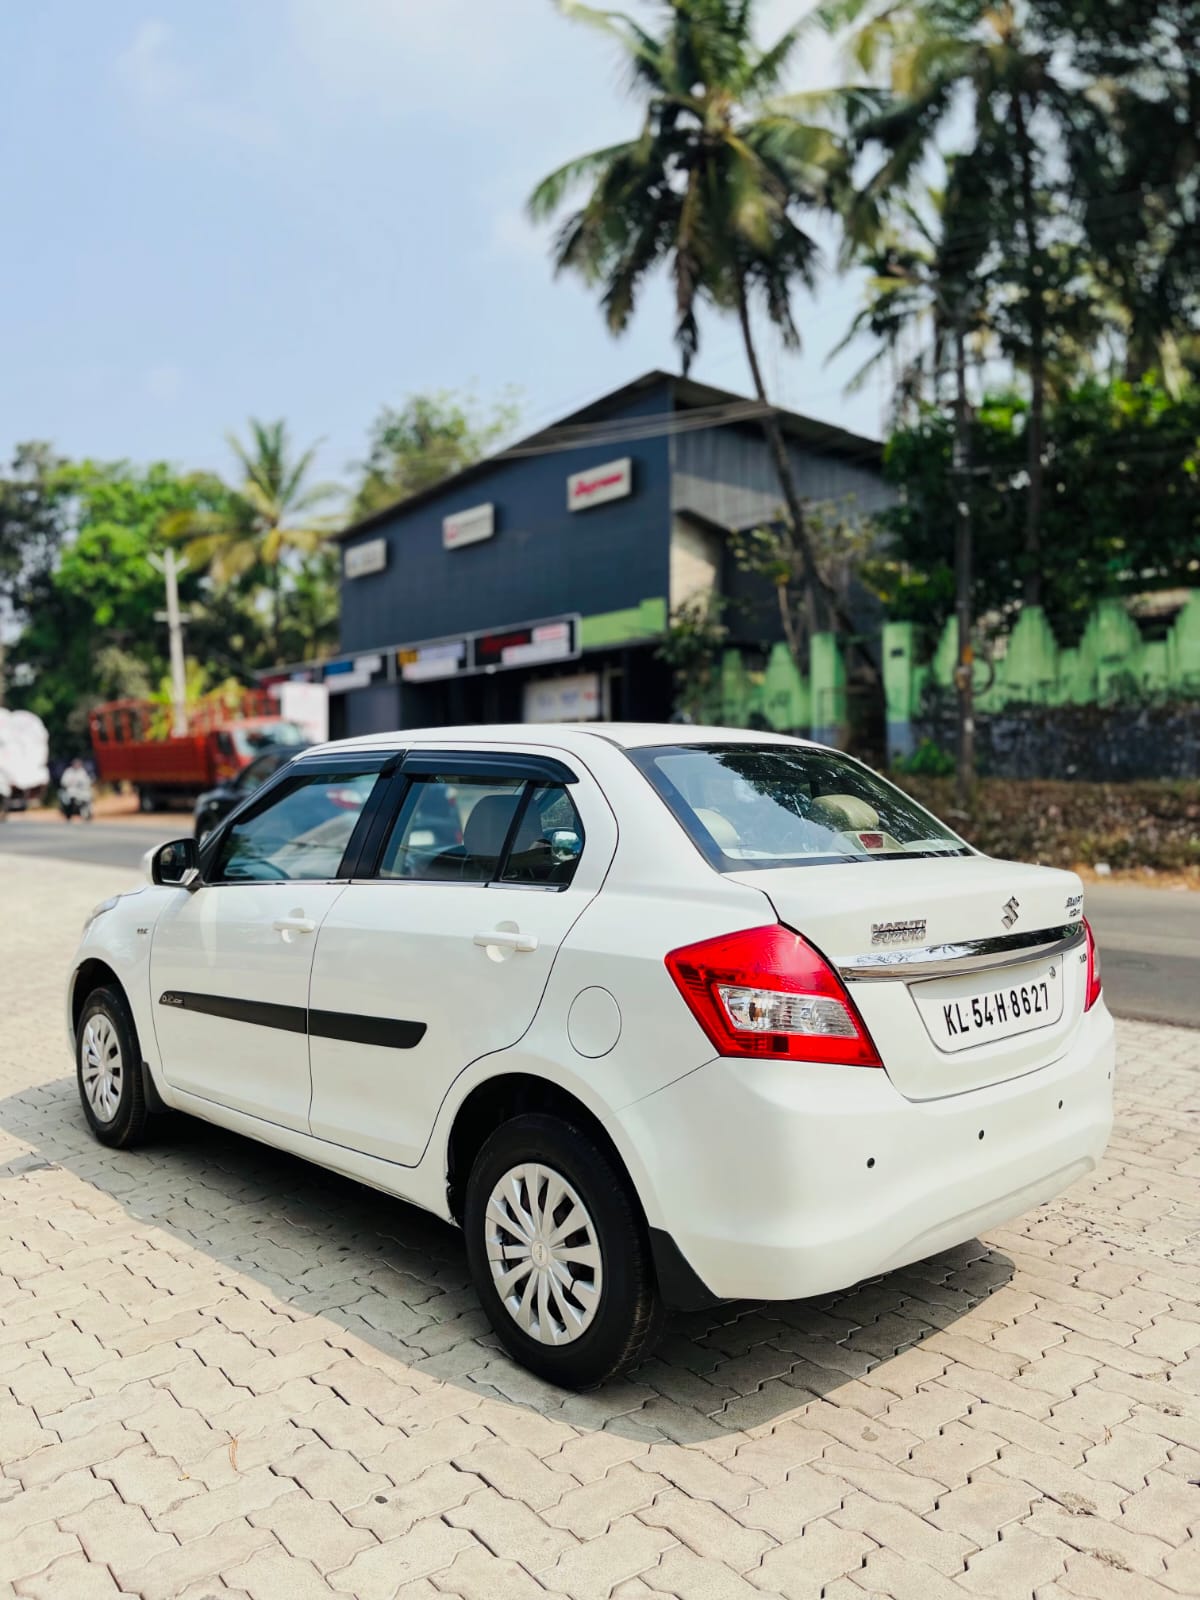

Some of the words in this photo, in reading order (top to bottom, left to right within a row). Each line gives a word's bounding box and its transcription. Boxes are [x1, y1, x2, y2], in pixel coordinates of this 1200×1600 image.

[943, 1003, 970, 1036] KL
[971, 996, 994, 1028] 54
[994, 992, 1008, 1023] H
[1009, 982, 1049, 1018] 8627
